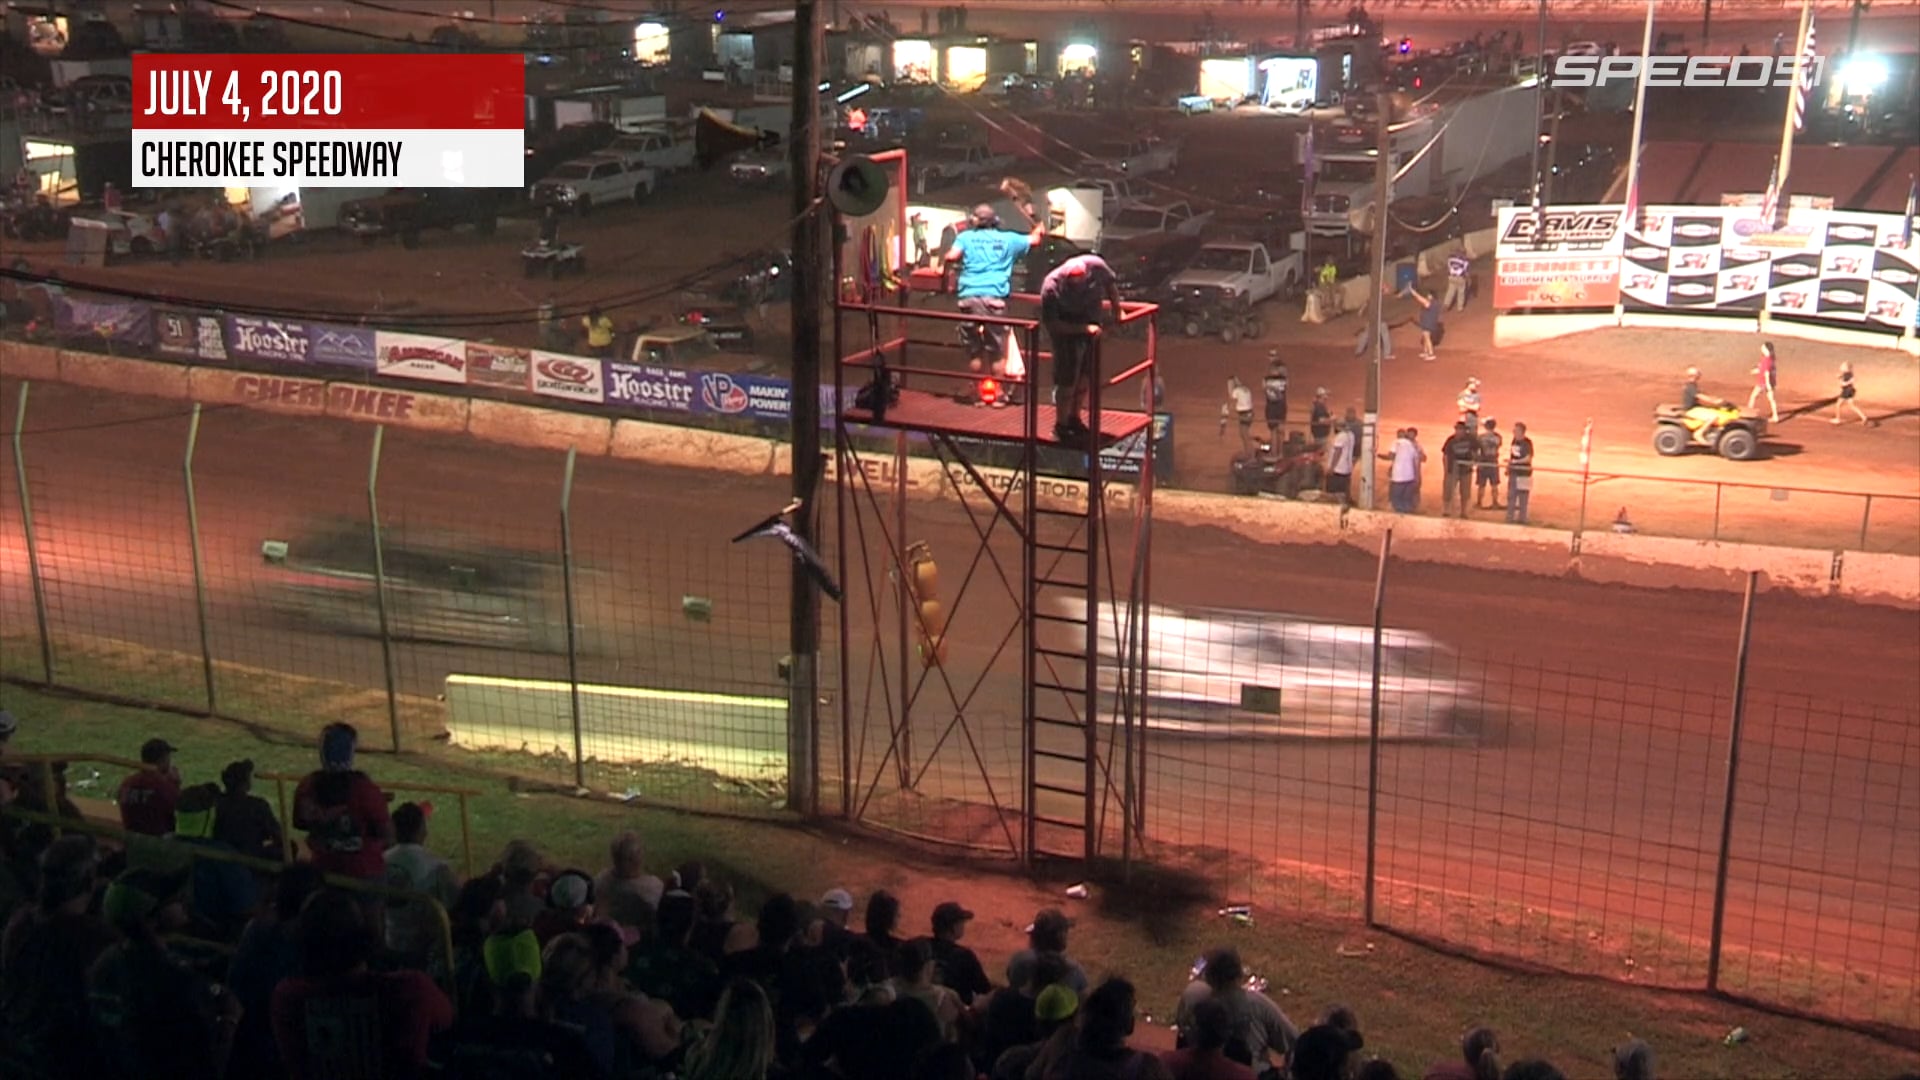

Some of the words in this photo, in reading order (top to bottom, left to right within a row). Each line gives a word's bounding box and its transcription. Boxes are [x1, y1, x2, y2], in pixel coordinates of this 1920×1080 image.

[1507, 216, 1616, 238] DAVIS
[1502, 260, 1612, 273] BENNETT
[235, 326, 308, 354] Hoosier
[388, 345, 465, 372] AMERICAN
[234, 376, 416, 419] CHEROKEE
[610, 372, 694, 402] Hoosier
[750, 385, 789, 399] MAKIN'
[750, 398, 792, 412] POWER!
[952, 468, 1080, 498] CONTRATOR
